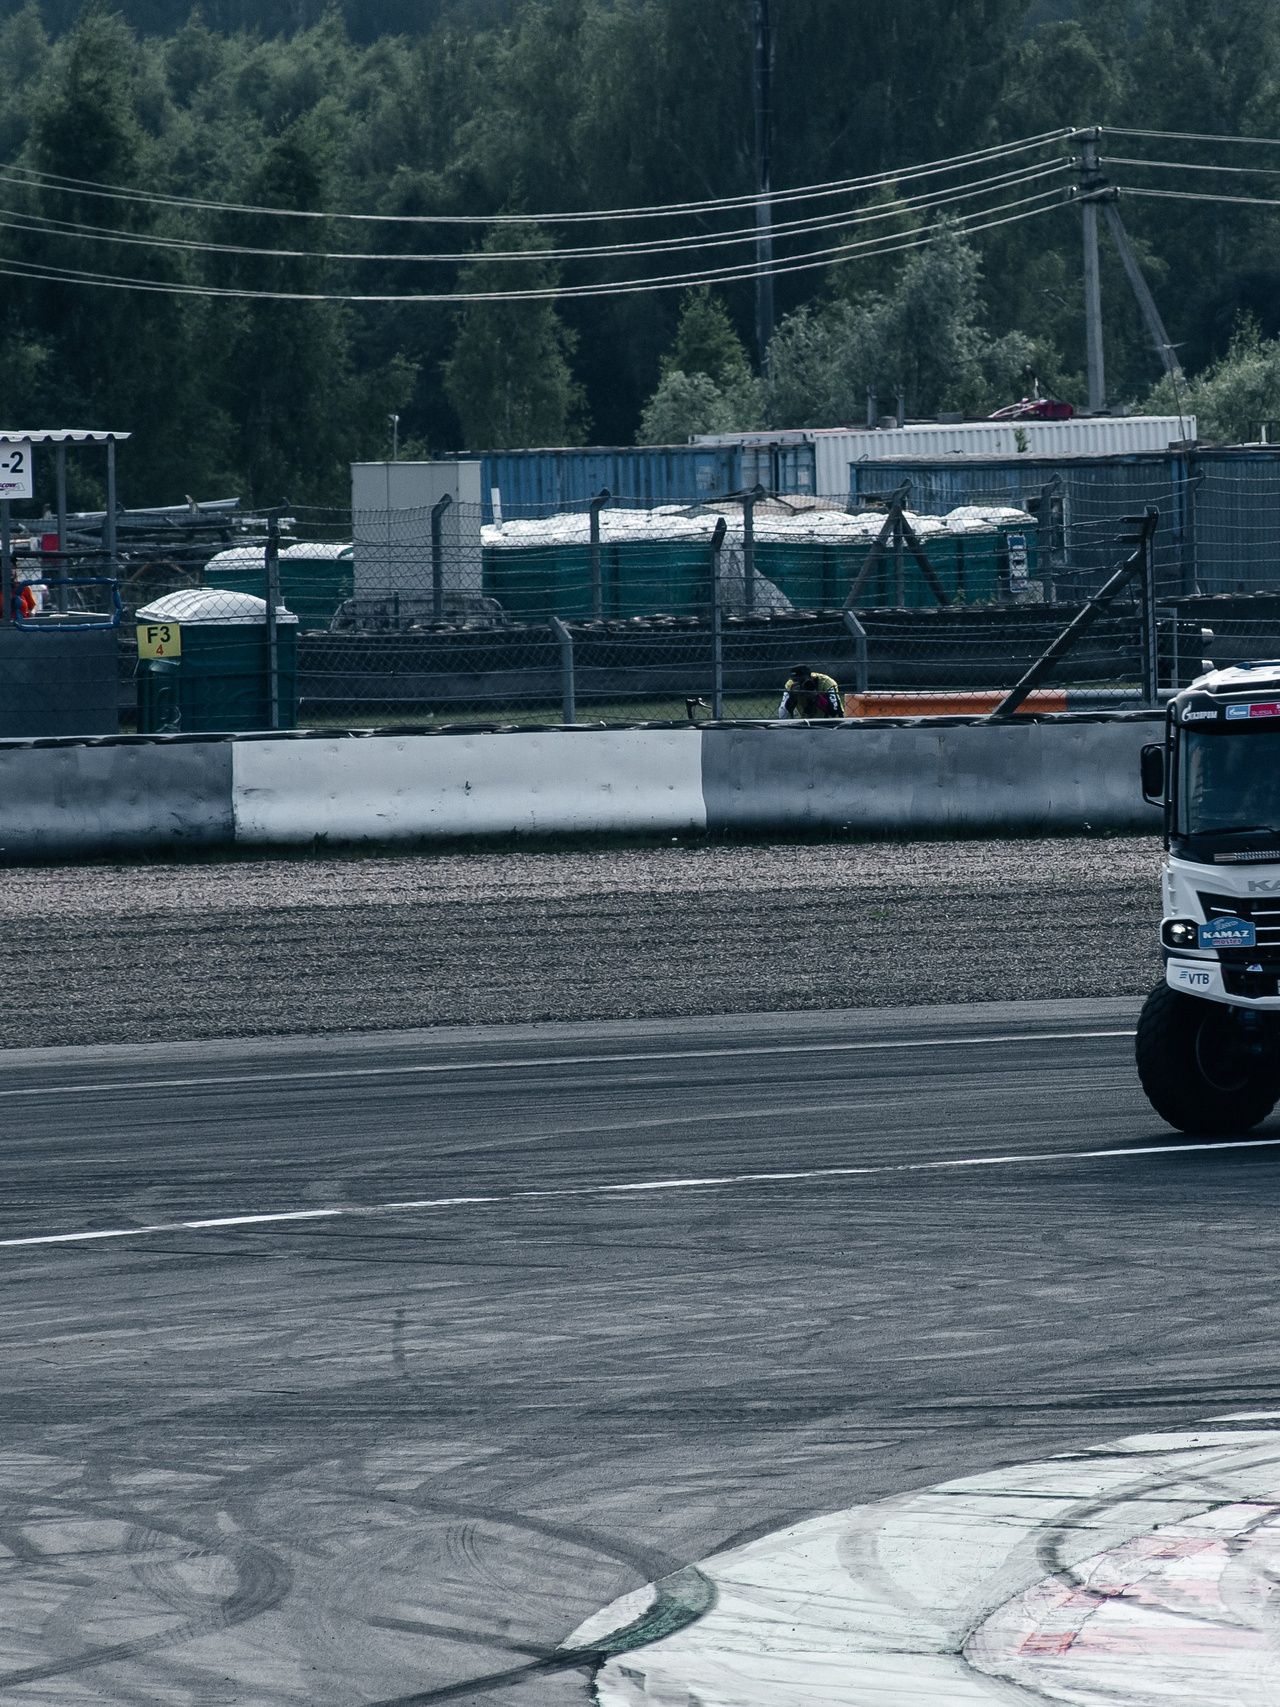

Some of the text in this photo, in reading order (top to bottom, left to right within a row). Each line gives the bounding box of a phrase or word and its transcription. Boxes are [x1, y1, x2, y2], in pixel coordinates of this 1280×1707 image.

[146, 625, 171, 644] F3
[155, 644, 164, 655] 4
[1202, 930, 1250, 939] KAMAZ
[1188, 973, 1210, 985] VTB
